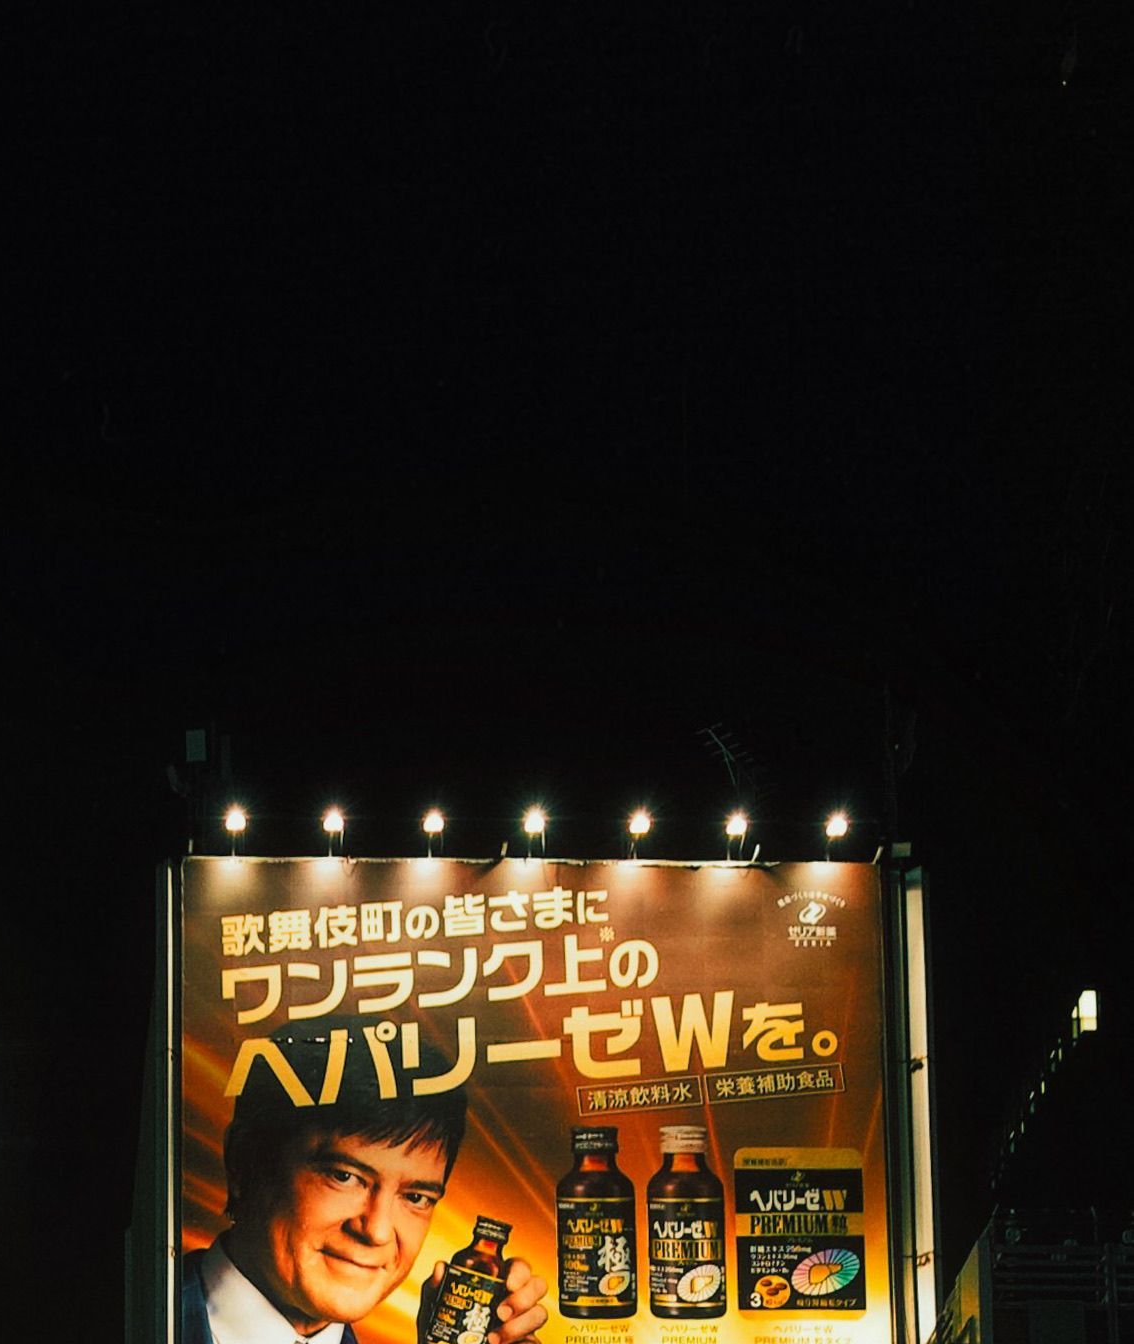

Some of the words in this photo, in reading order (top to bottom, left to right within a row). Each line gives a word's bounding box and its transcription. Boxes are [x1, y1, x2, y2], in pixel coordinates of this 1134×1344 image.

[219, 885, 609, 958] 歌舞伎町の皆さまに
[223, 989, 839, 1109] ヘパリーゼWを。
[587, 1082, 693, 1111] 清涼飲料水
[715, 1069, 834, 1099] 栄養補助食品
[749, 1214, 829, 1235] PREMIUM
[597, 1235, 631, 1273] 極
[653, 1240, 722, 1260] PREMIUM
[749, 1292, 763, 1308] 3
